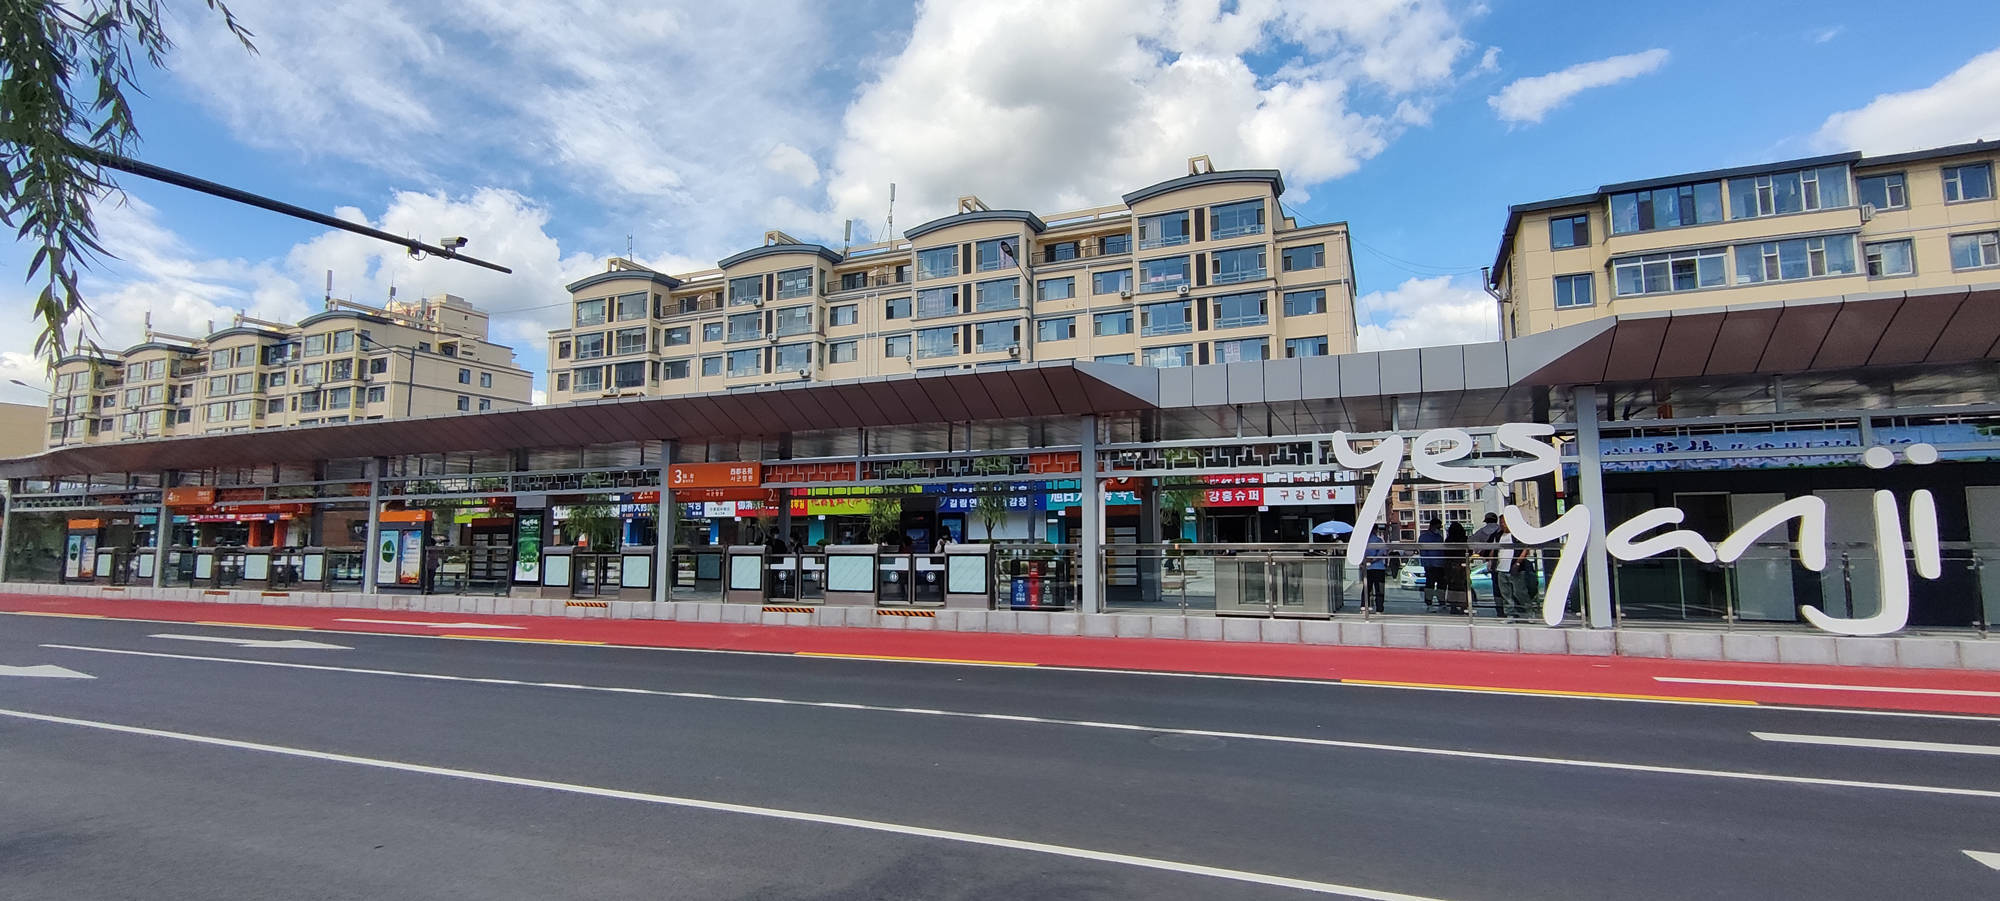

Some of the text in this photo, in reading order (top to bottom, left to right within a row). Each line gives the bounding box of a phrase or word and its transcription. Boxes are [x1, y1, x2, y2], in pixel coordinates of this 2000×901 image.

[674, 469, 682, 484] 3
[1332, 423, 1560, 565] yes
[1504, 443, 1941, 635] yanji
